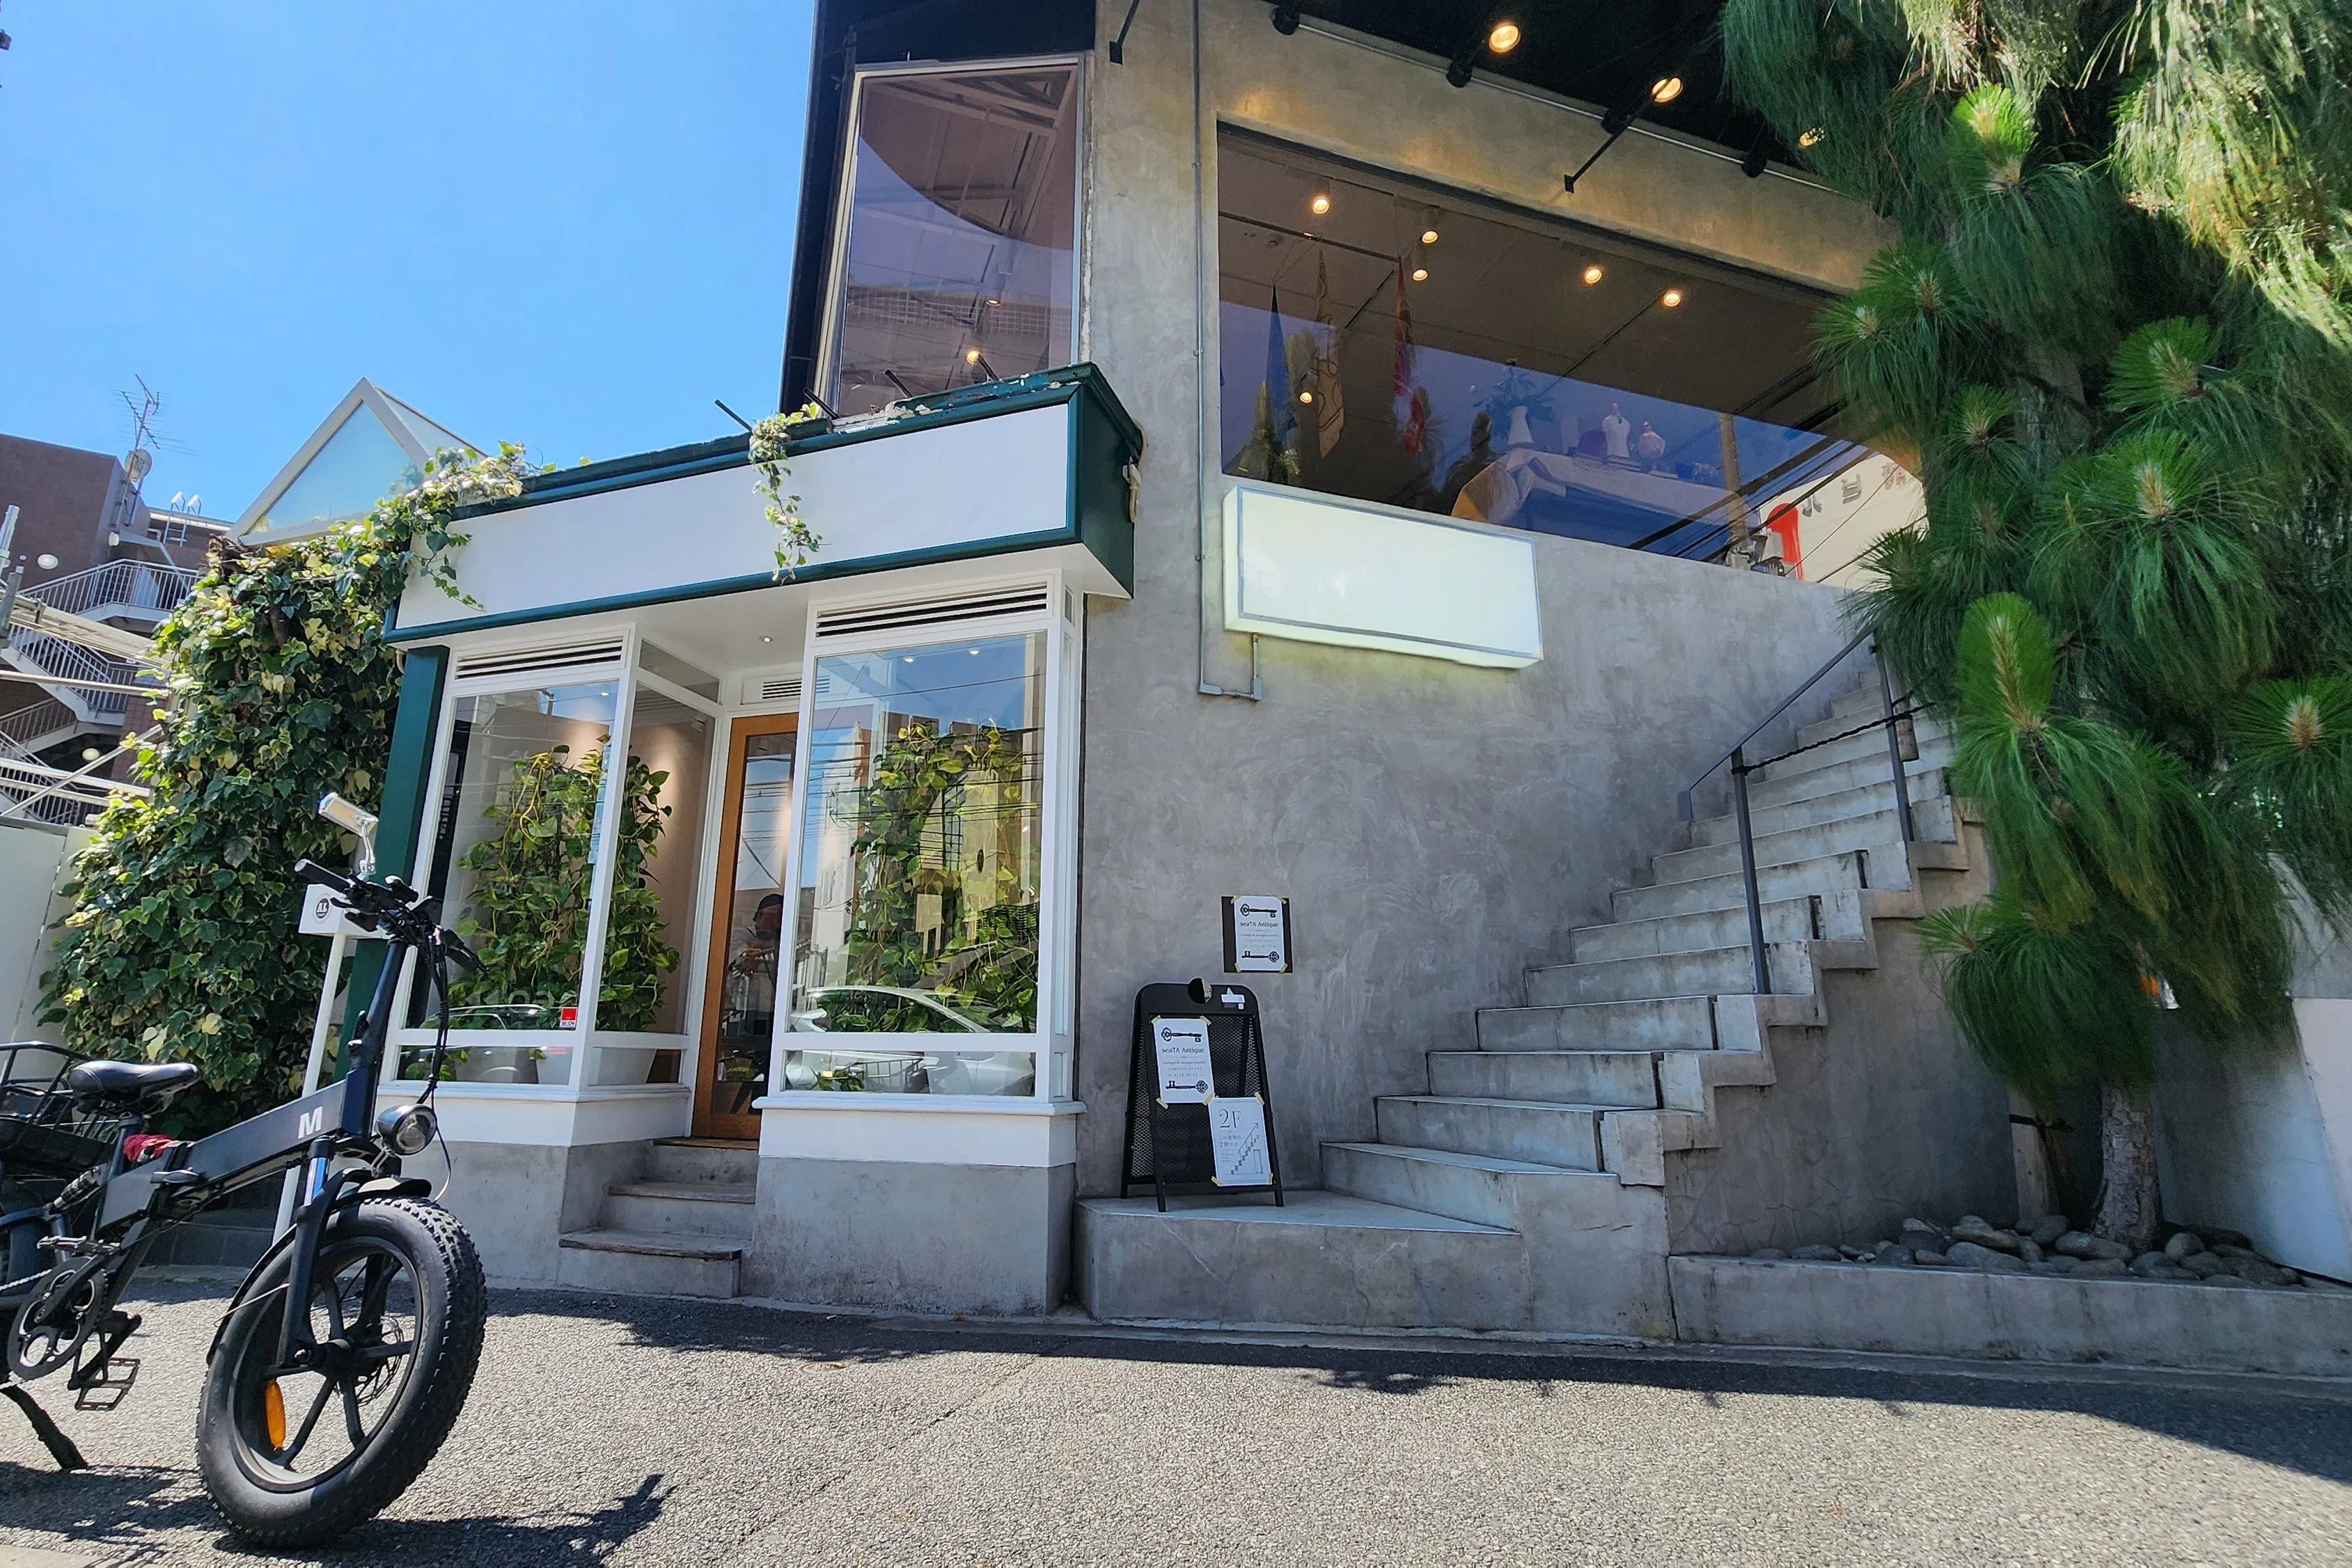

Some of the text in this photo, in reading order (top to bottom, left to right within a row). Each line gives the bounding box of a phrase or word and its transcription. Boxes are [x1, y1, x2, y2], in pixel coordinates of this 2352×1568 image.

[316, 902, 327, 912] AL
[297, 1106, 322, 1139] M
[1218, 1108, 1241, 1129] 2F
